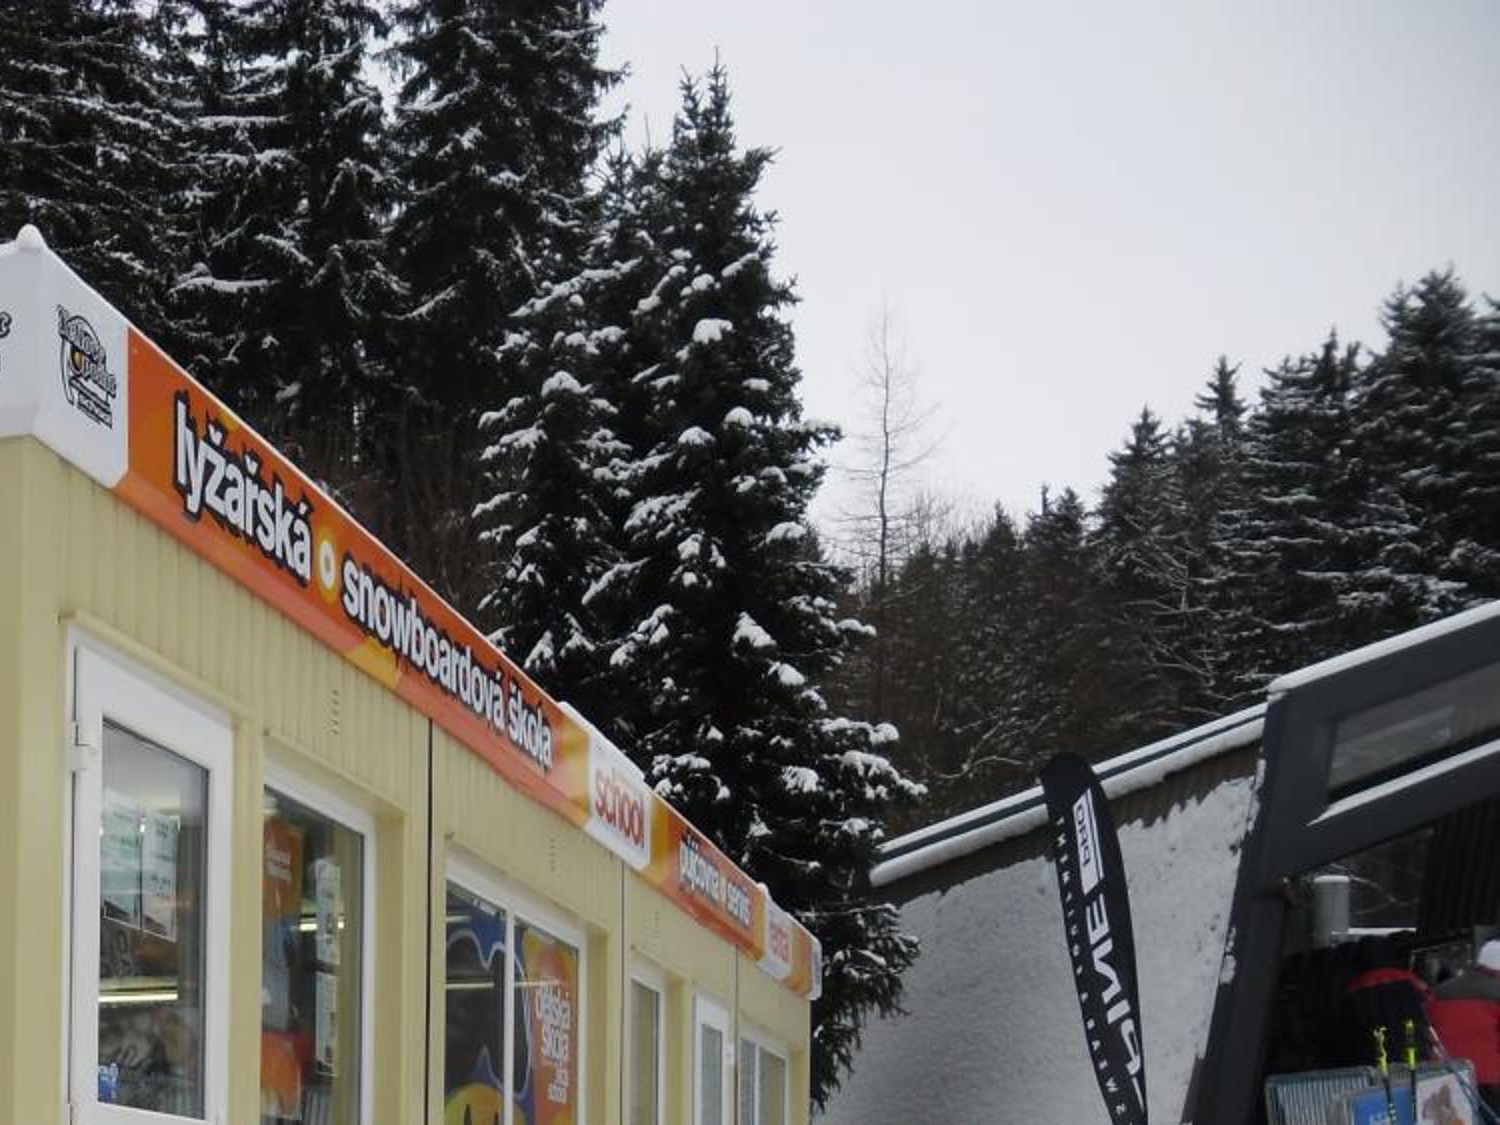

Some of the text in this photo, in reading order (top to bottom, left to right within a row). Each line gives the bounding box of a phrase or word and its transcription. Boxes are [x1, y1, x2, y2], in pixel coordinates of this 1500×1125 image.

[176, 398, 553, 770] lyžařská snowboardová škola
